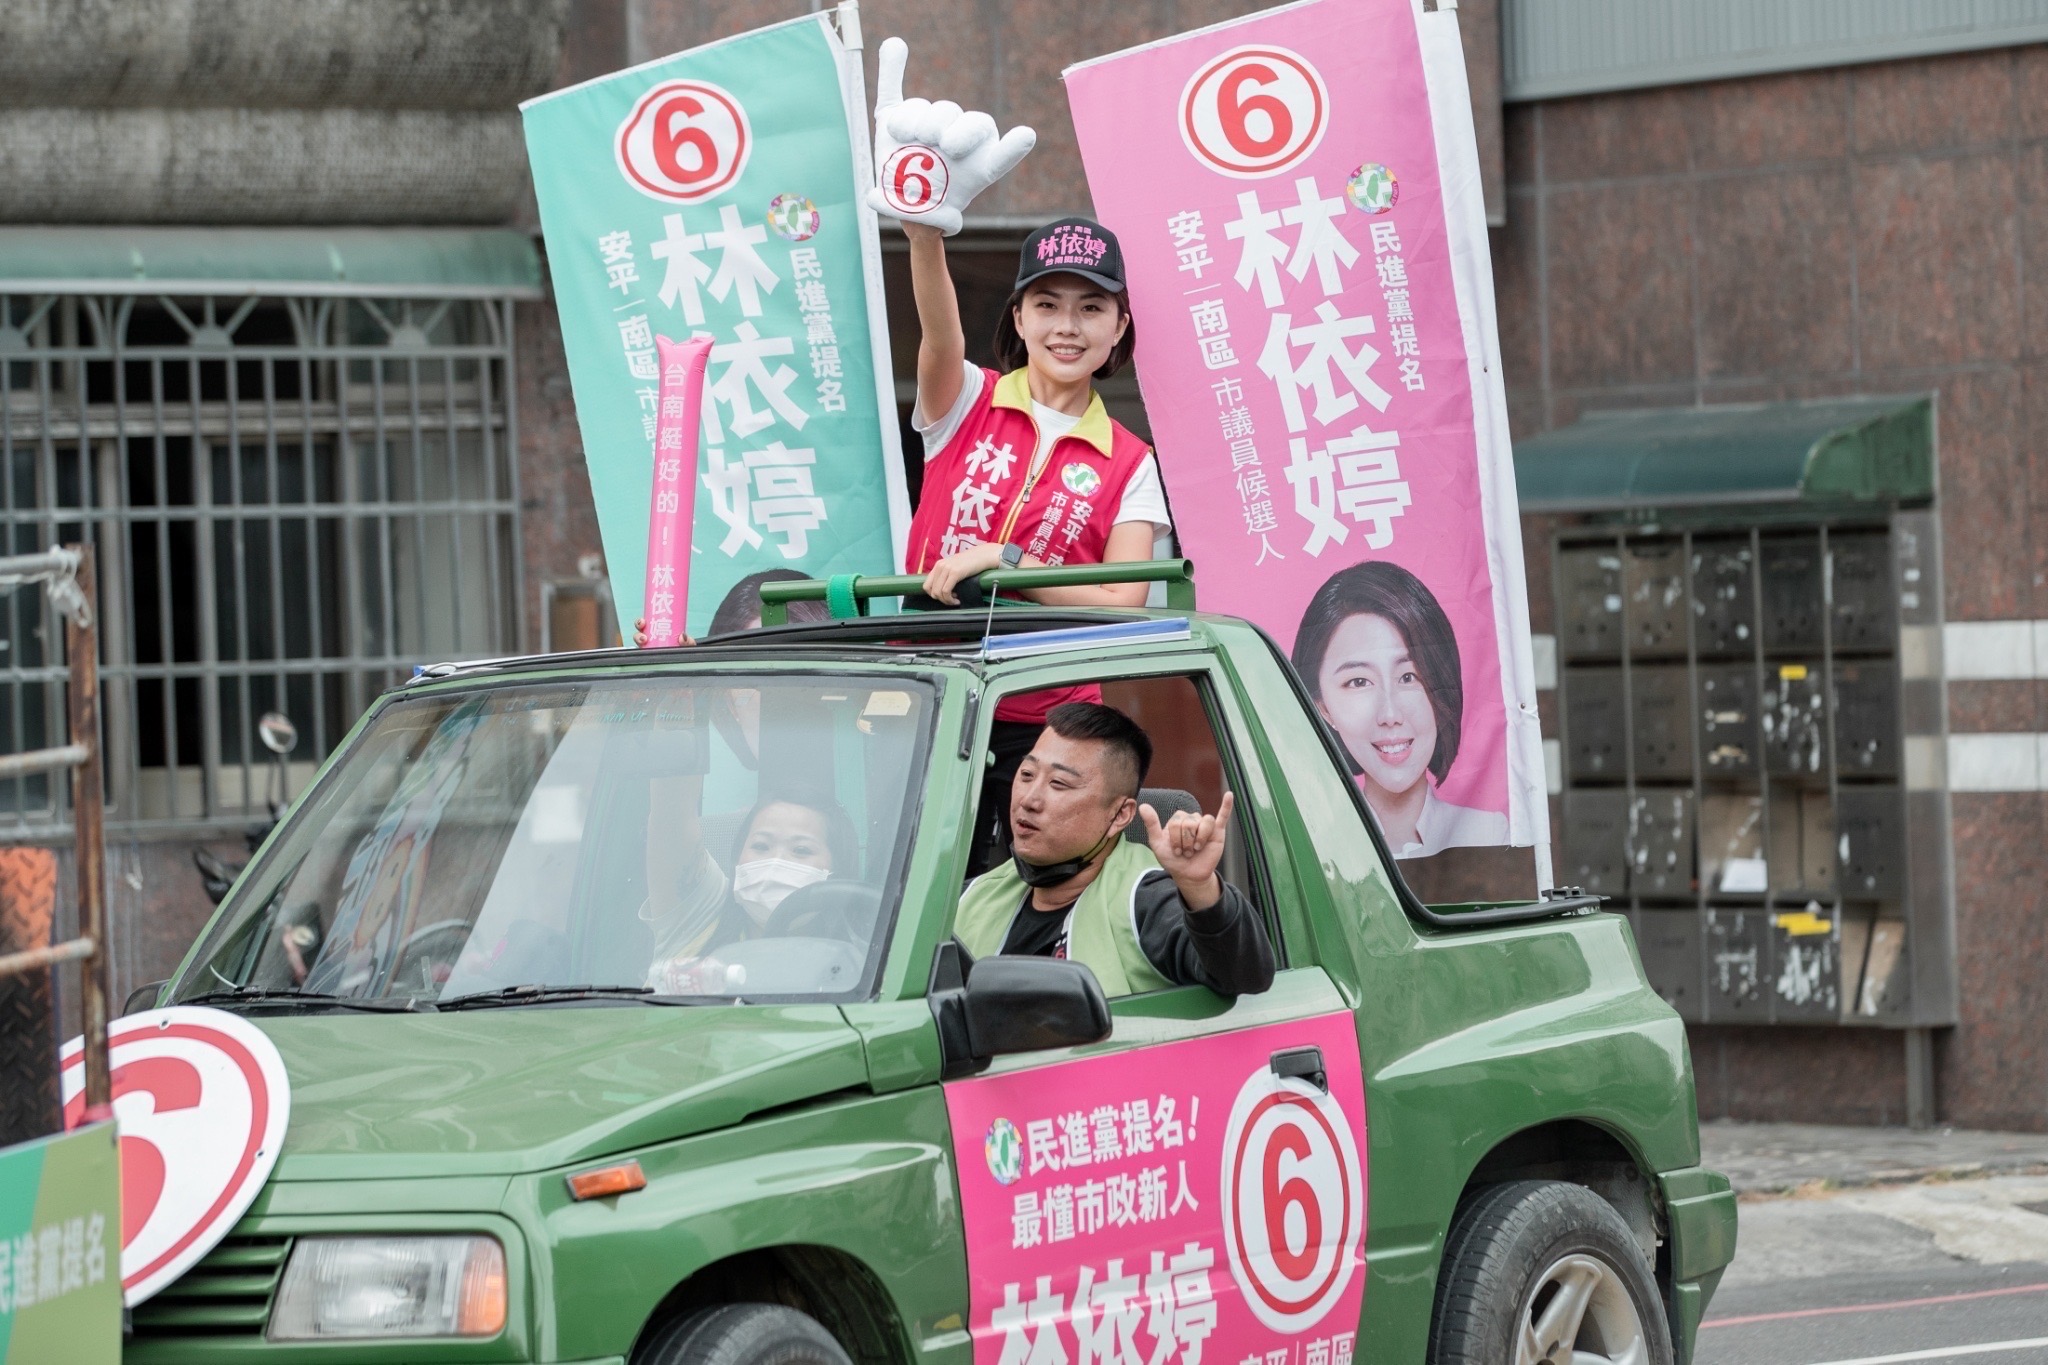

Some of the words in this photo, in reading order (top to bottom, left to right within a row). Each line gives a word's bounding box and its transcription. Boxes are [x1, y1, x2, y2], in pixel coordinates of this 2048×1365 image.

[653, 96, 719, 184] 6
[1217, 63, 1293, 157] 6
[894, 152, 935, 206] 6
[1036, 233, 1107, 260] 林依婷
[1369, 221, 1426, 392] 民進黨提名
[650, 204, 828, 559] 林依婷
[789, 247, 847, 412] 民進黨提名
[1224, 176, 1412, 558] 林依婷
[656, 363, 687, 546] 台南挺好的!
[1211, 377, 1286, 567] 市議員候選人
[649, 564, 675, 643] 林依婷
[1027, 1094, 1200, 1176] 民進黨提名!
[1011, 1160, 1199, 1249] 最懂市政新人
[1262, 1122, 1322, 1281] 6
[991, 1242, 1217, 1365] 林依婷
